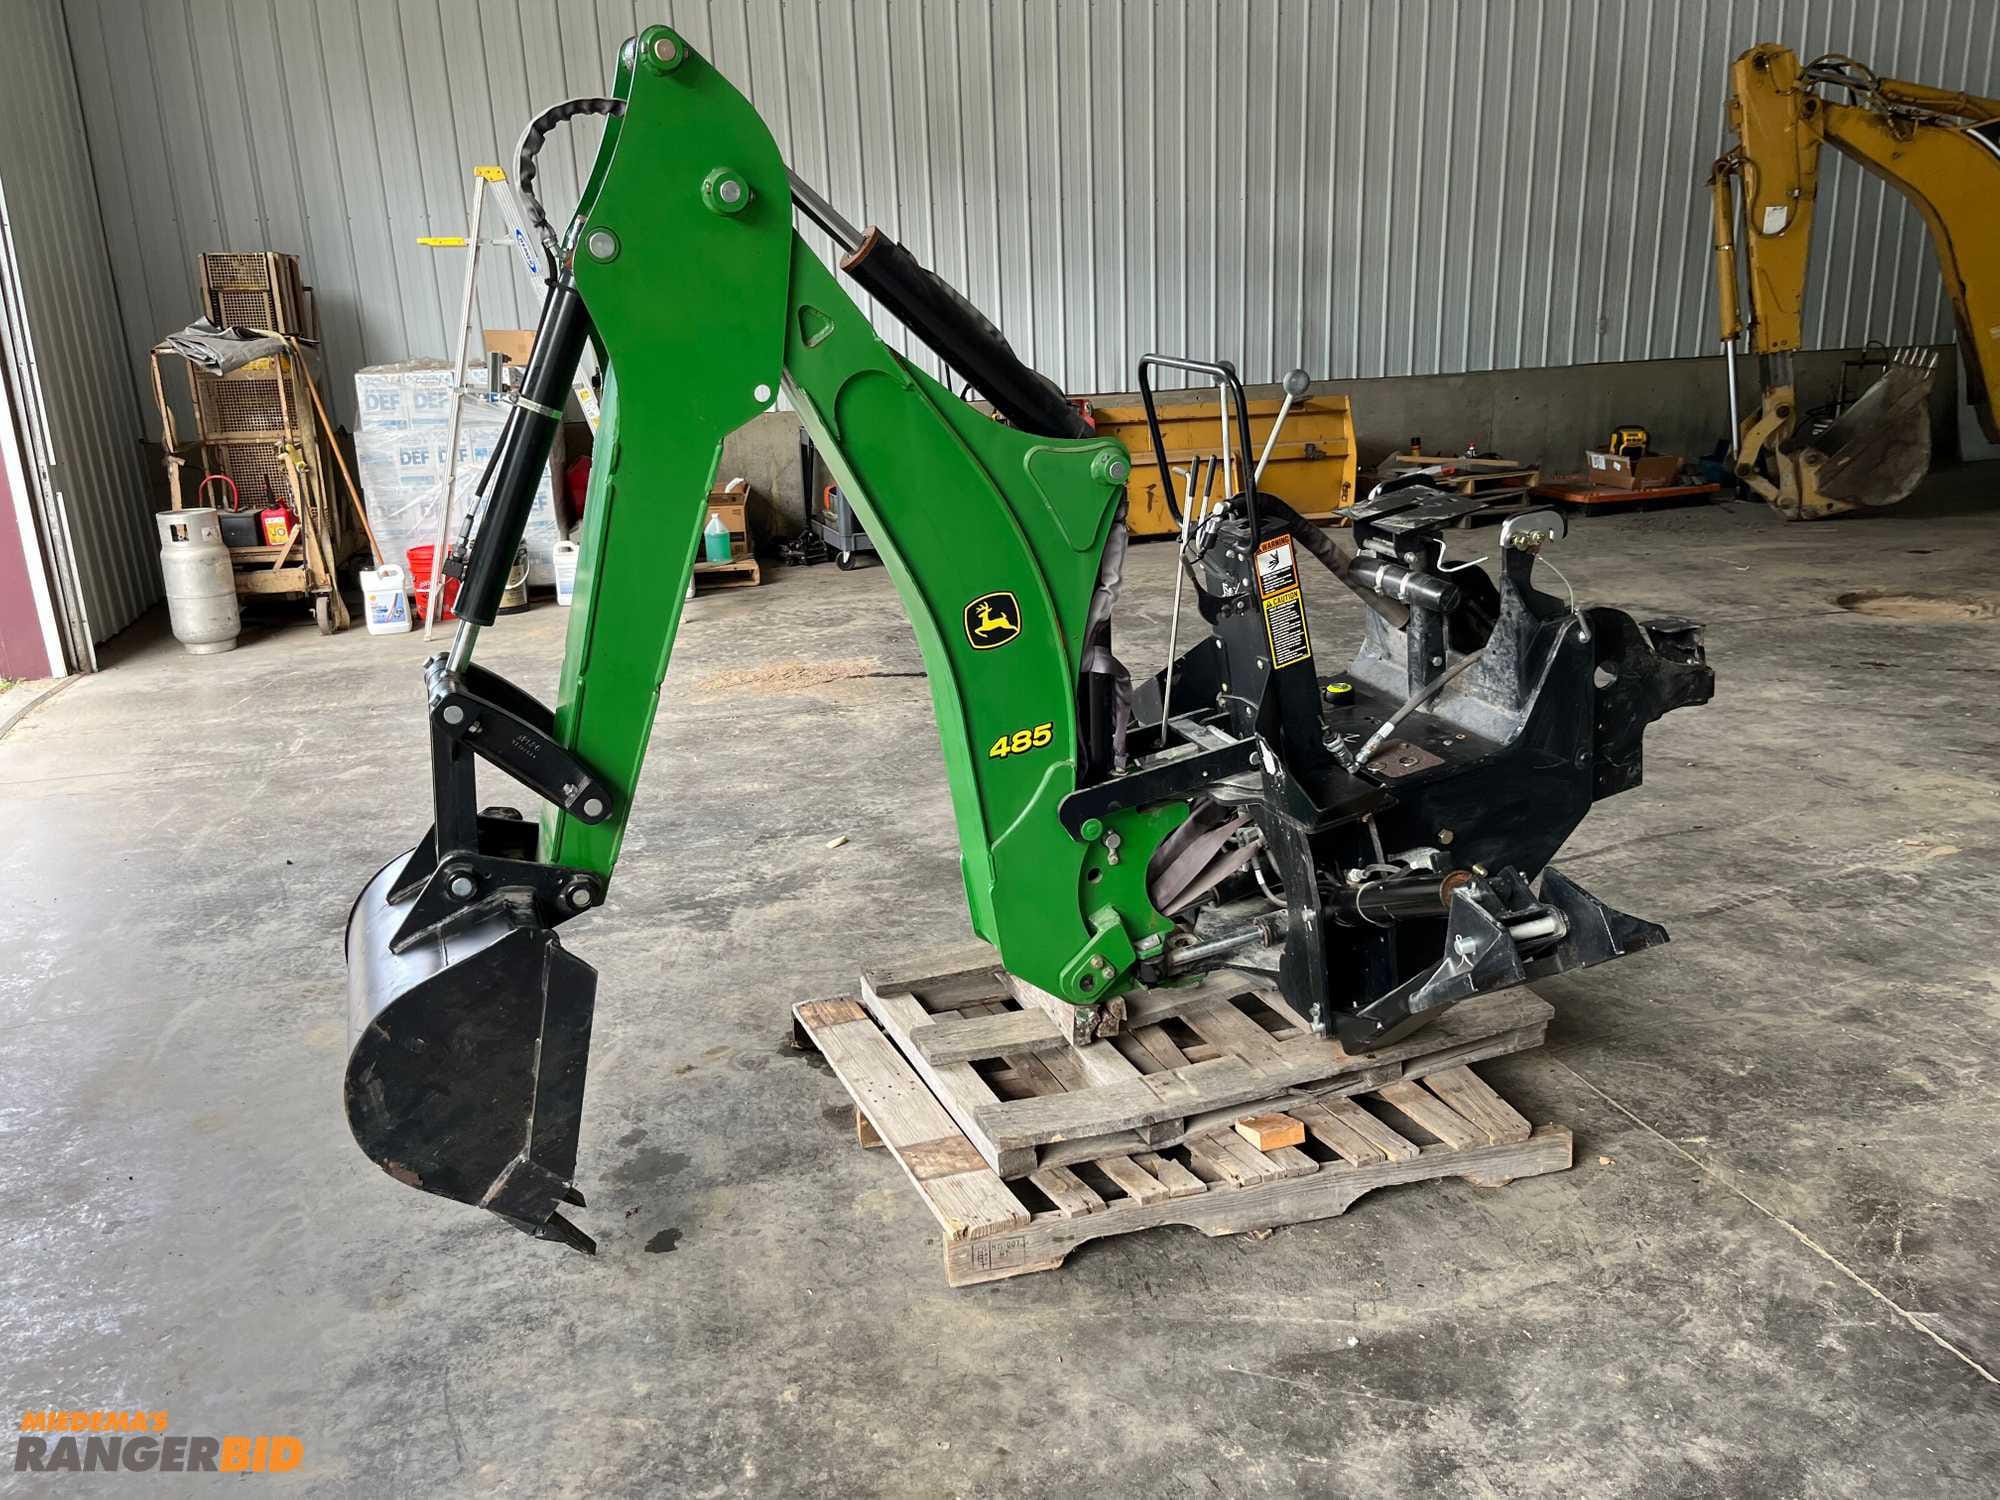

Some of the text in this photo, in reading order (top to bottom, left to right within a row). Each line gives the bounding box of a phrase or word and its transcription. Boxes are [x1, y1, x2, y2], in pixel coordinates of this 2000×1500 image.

[367, 393, 401, 410] DEF
[401, 451, 430, 466] DEF
[438, 449, 468, 464] DF
[1261, 535, 1290, 551] WARNING
[1273, 590, 1298, 604] CAUTION
[989, 722, 1053, 759] 485
